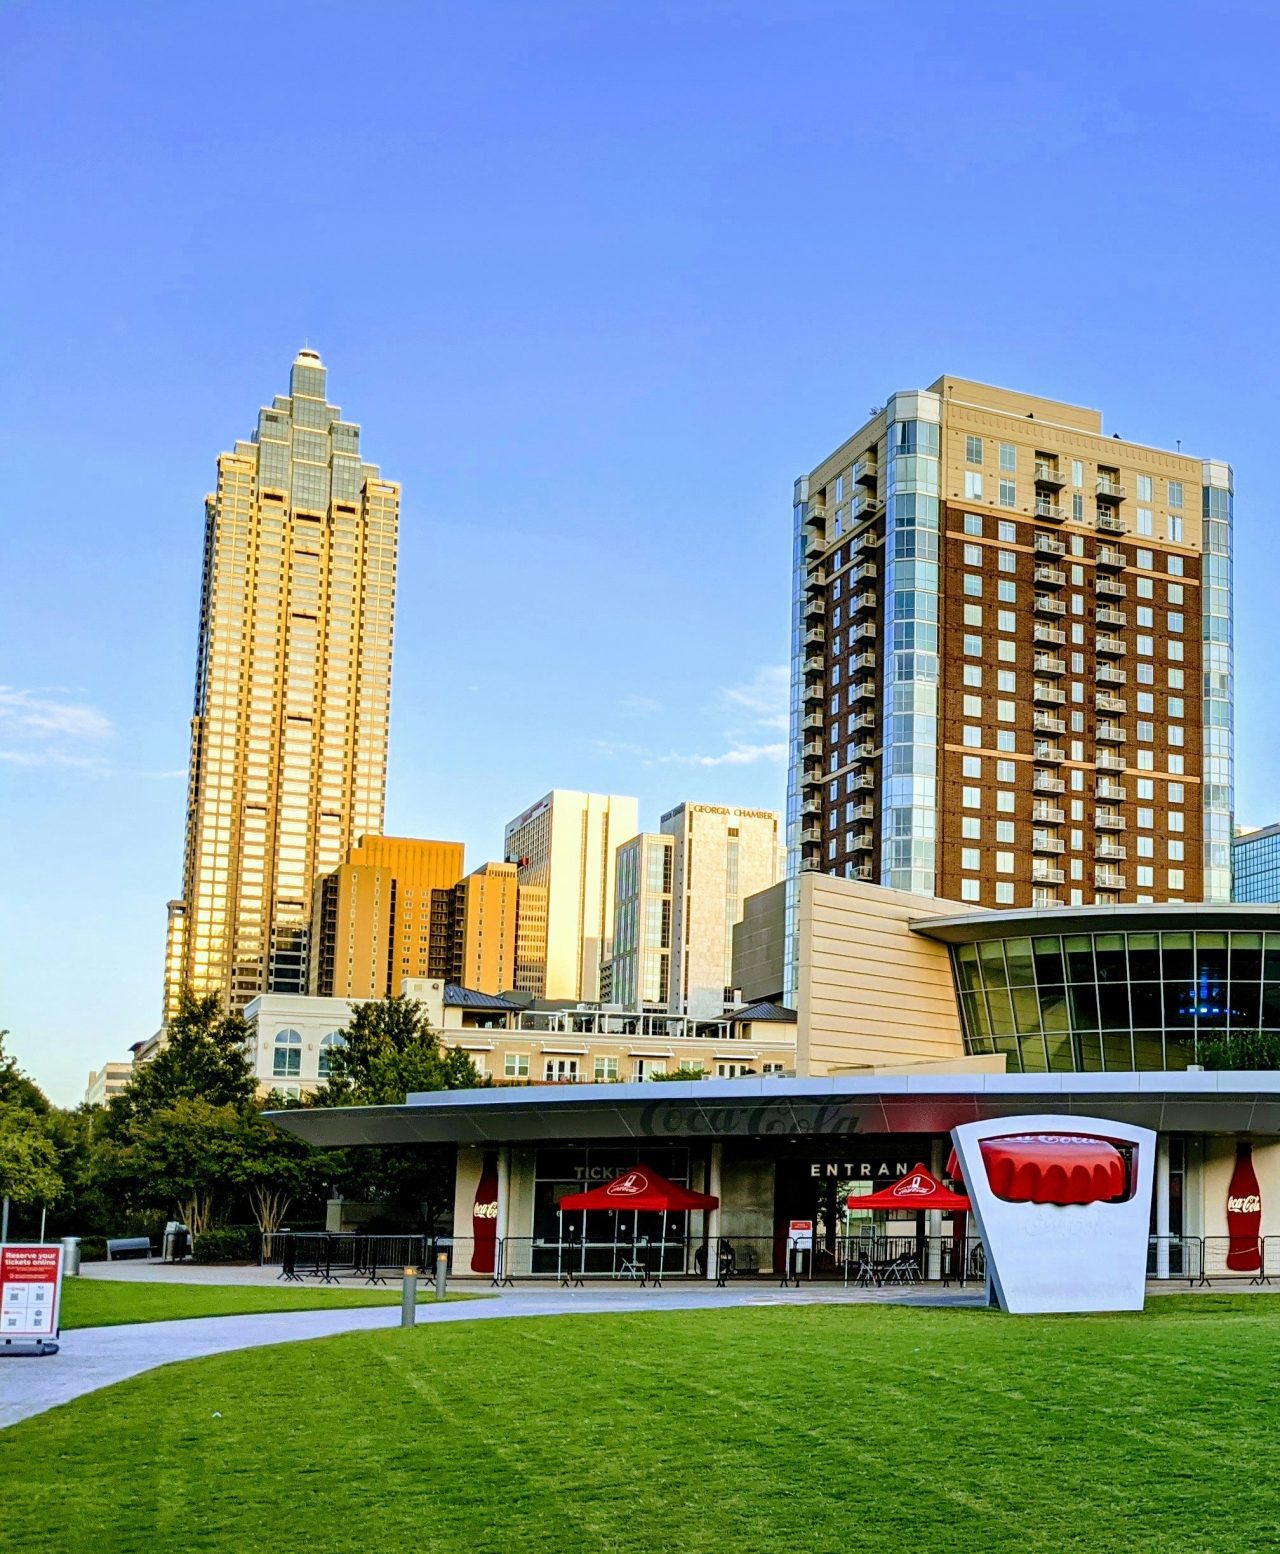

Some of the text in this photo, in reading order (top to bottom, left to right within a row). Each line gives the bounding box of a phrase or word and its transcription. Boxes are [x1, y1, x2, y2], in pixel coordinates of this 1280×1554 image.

[694, 804, 731, 816] GEORGIA
[733, 808, 773, 820] CHAMBER
[810, 1162, 911, 1177] ENTRAN
